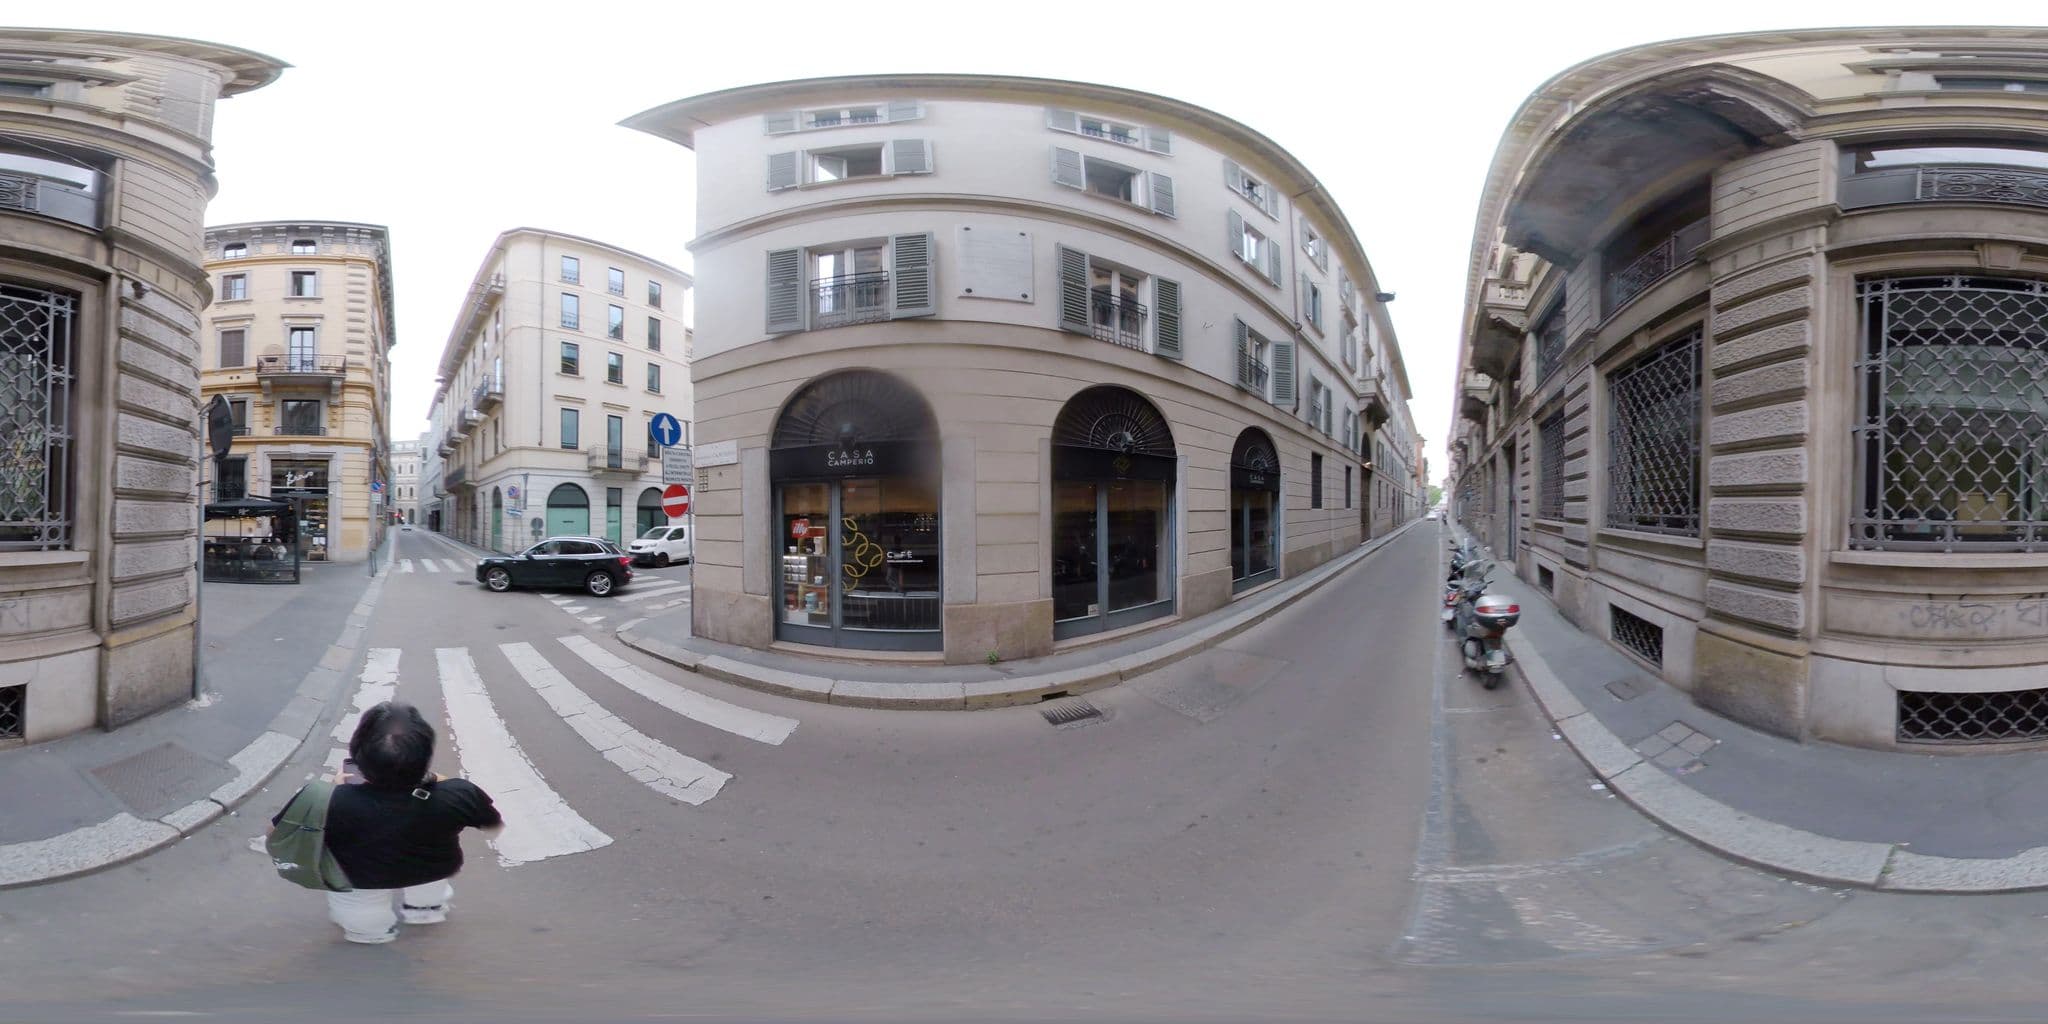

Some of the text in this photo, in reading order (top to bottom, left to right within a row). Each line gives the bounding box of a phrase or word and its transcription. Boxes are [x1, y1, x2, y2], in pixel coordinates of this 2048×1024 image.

[828, 449, 873, 460] CASA
[828, 458, 874, 467] CAMPERIO
[792, 522, 808, 535] illy
